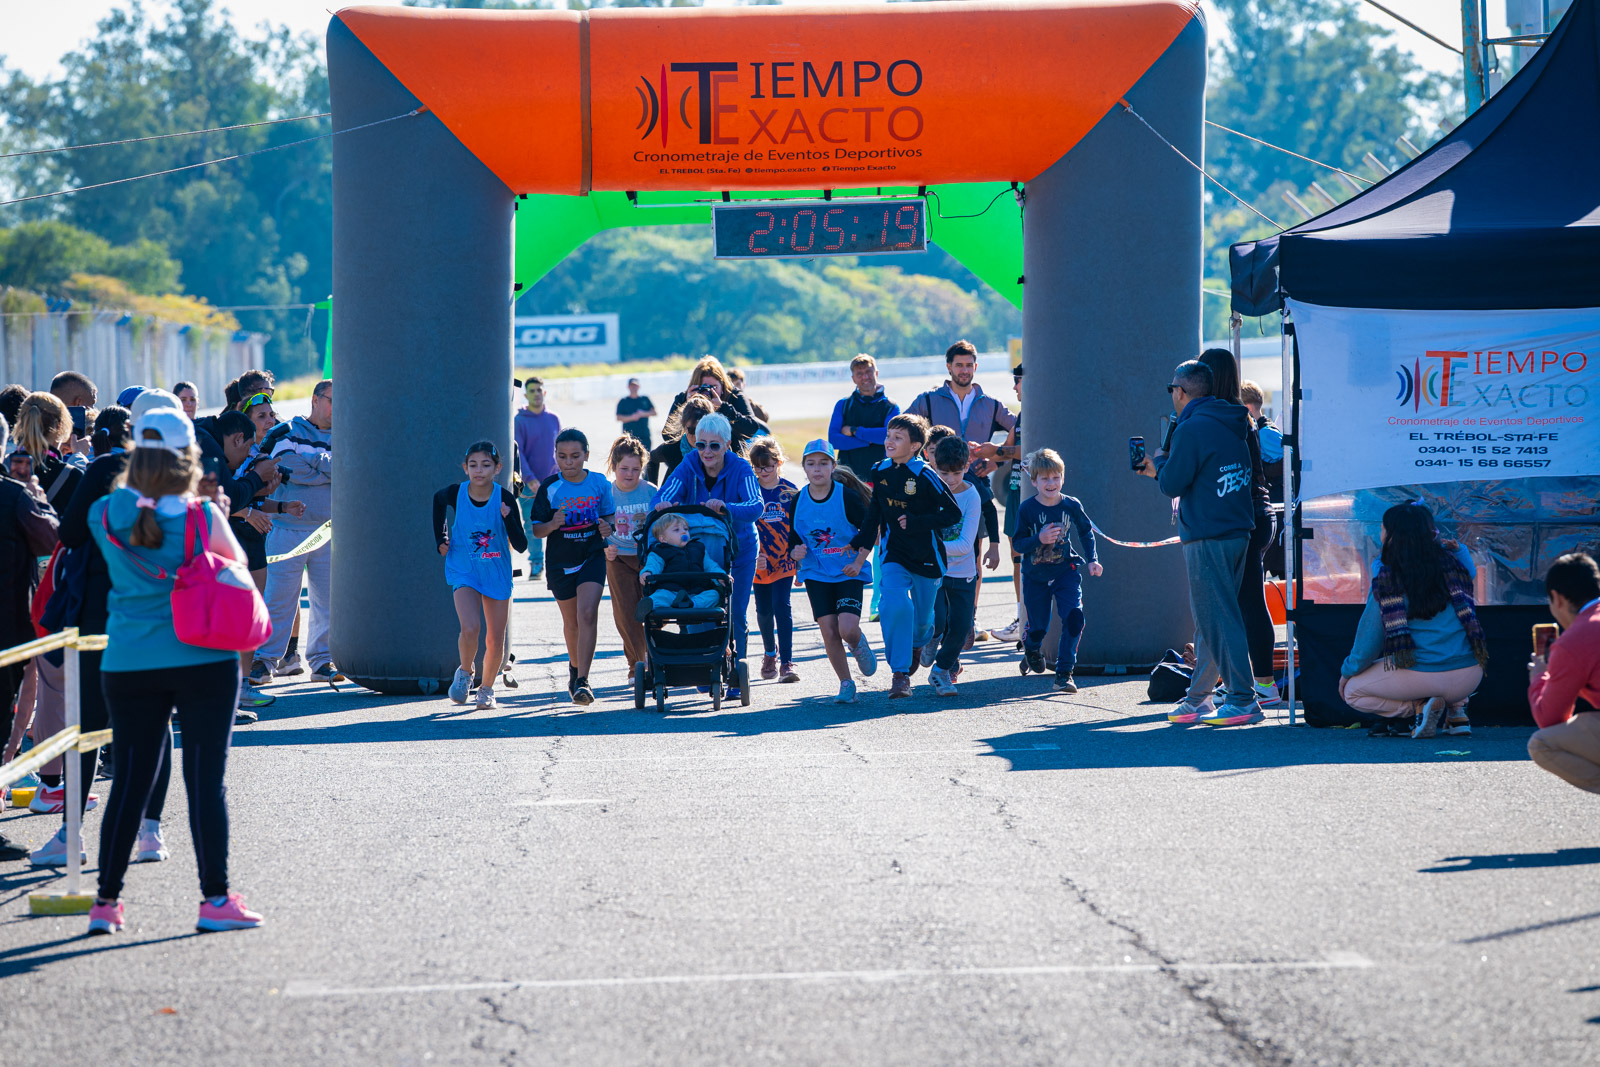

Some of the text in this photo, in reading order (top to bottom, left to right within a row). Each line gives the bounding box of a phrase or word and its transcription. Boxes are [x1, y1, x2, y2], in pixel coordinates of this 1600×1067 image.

[713, 74, 924, 145] EXACTO
[633, 147, 923, 163] Cronometraje de Eventos Deportivos
[515, 326, 599, 345] ONG
[1426, 351, 1588, 407] TIEMPO
[1449, 362, 1589, 408] EXACTO
[1388, 416, 1584, 427] Cronometraje de Eventos Deportivos
[1409, 432, 1429, 441] EL
[1418, 446, 1548, 454] 03401- 15 52 7413
[1415, 459, 1551, 468] 0341- 15 68 66557
[886, 497, 908, 509] YPF
